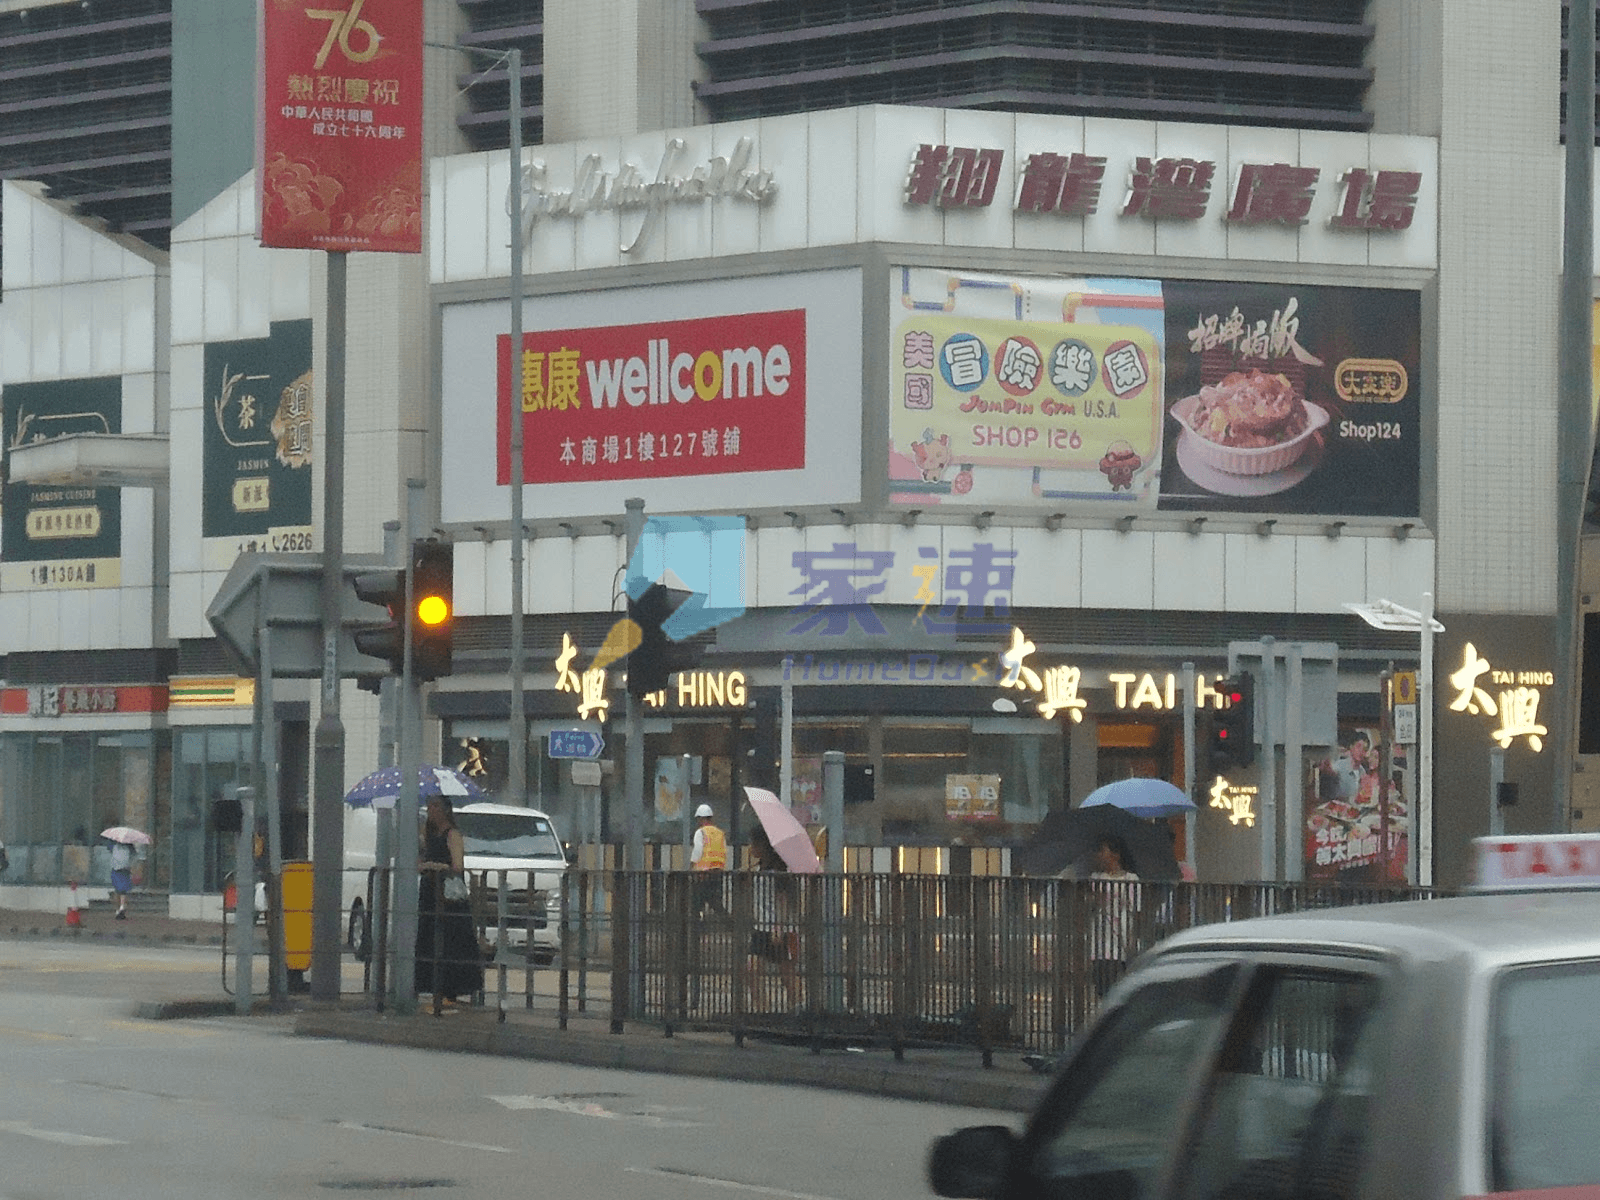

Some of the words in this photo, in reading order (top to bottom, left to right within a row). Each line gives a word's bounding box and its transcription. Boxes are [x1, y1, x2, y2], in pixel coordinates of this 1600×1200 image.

[304, 0, 380, 70] 76
[585, 338, 791, 409] wellcome
[903, 331, 934, 409] 美國
[944, 338, 1148, 396] 冒險樂園
[972, 425, 1039, 447] SHOP
[1047, 428, 1082, 449] 126
[1340, 420, 1401, 442] Shop124
[282, 532, 312, 552] 2626
[555, 632, 608, 723] 太興
[678, 671, 746, 708] HING
[1000, 627, 1087, 723] 太興
[1109, 673, 1175, 710] TAI
[1449, 641, 1548, 753] 太興
[1492, 671, 1514, 684] TAI
[1518, 671, 1554, 685] HING
[1210, 775, 1255, 828] 太興
